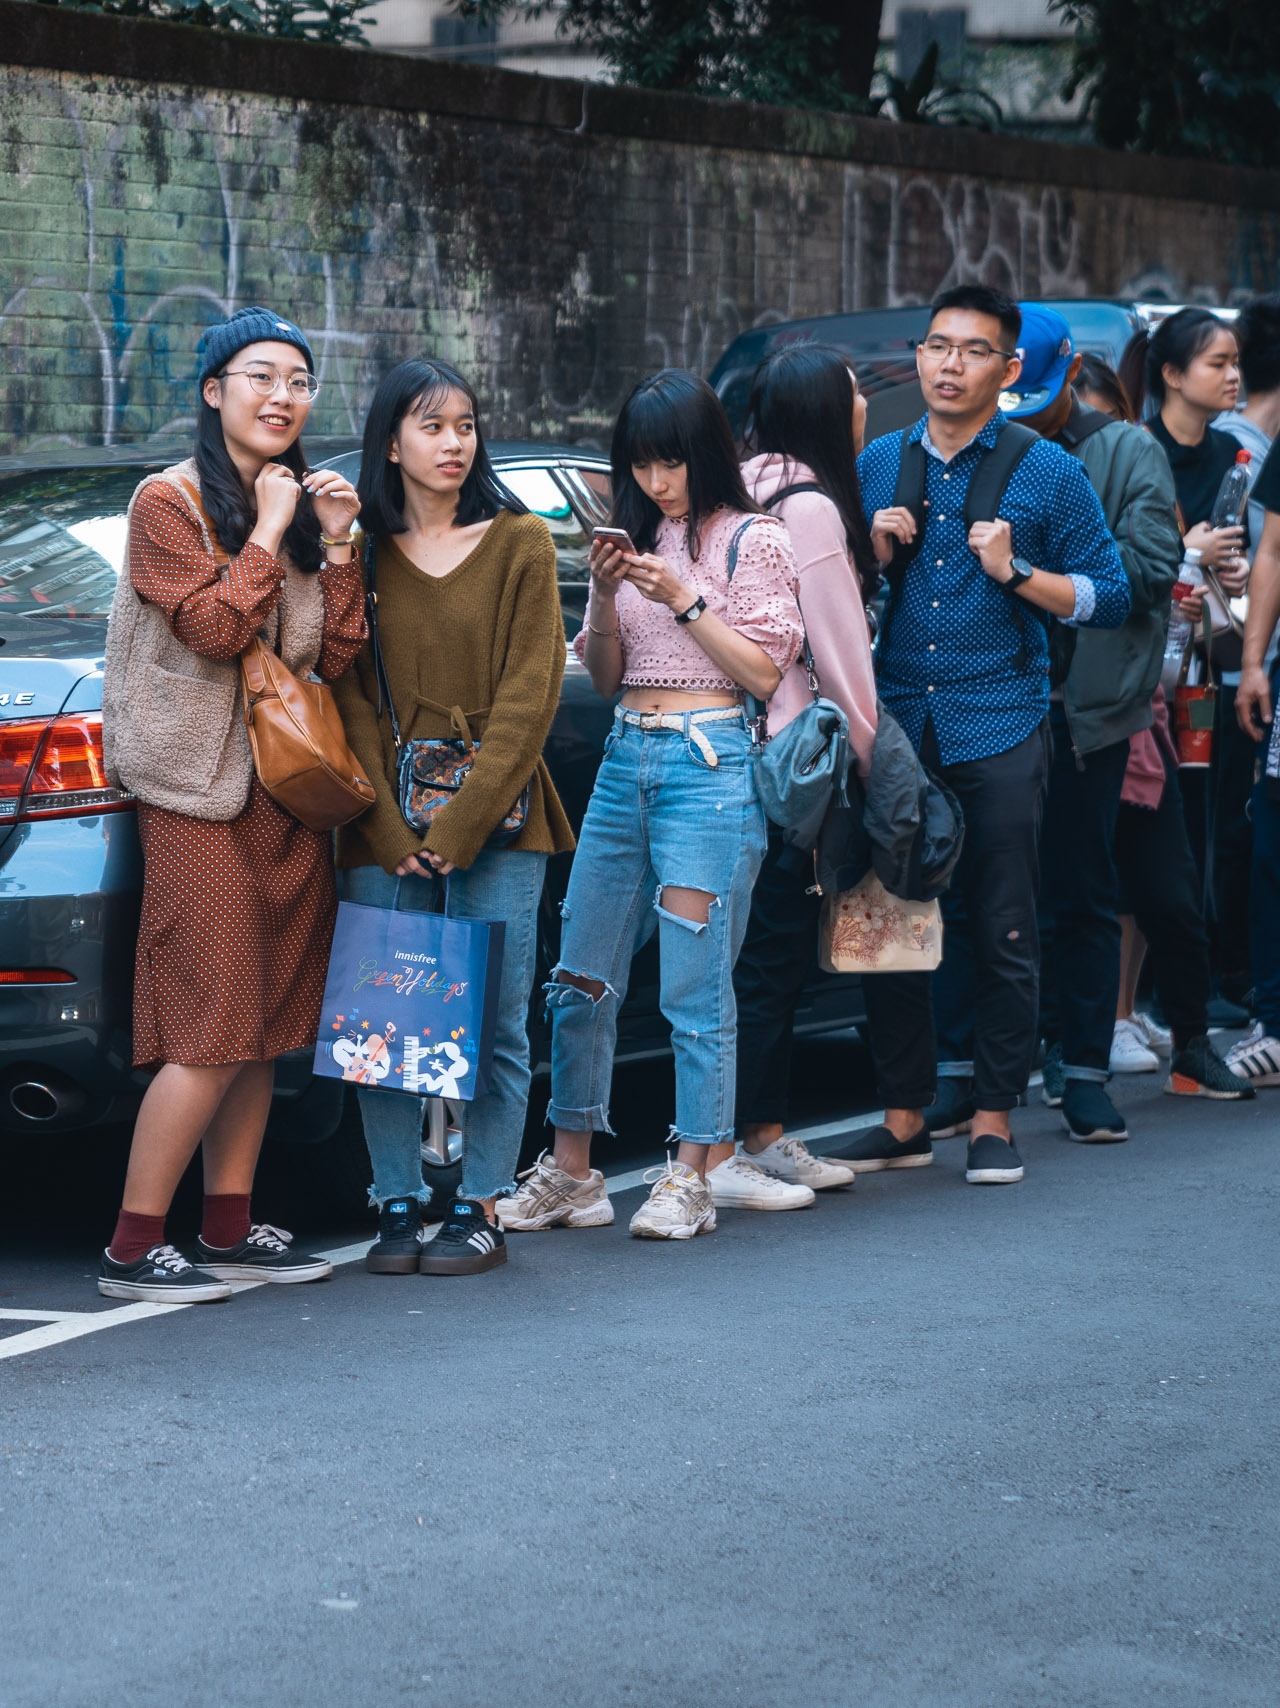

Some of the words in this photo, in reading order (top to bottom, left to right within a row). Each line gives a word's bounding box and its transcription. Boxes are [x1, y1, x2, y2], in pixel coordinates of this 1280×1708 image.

[13, 692, 35, 706] E
[394, 950, 437, 965] innisfree
[353, 956, 404, 992] Green
[395, 965, 468, 1003] Holidays
